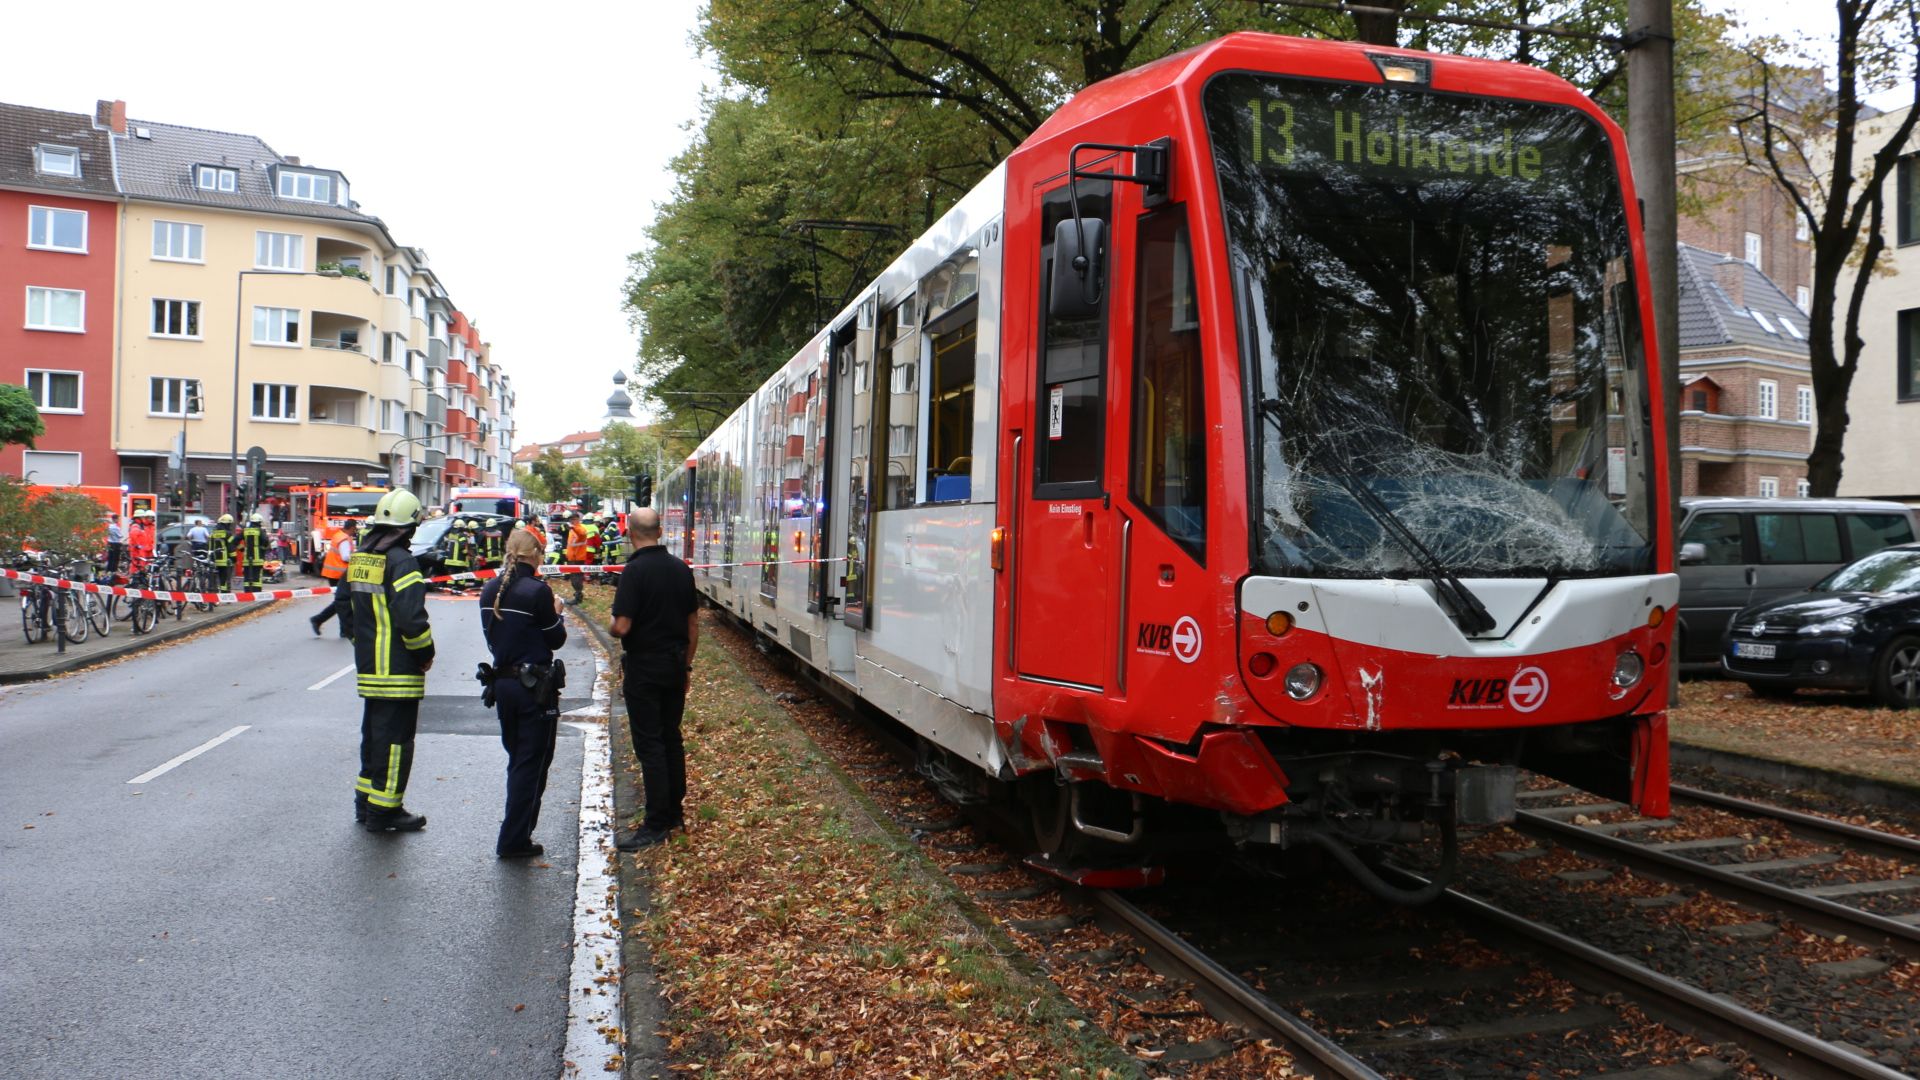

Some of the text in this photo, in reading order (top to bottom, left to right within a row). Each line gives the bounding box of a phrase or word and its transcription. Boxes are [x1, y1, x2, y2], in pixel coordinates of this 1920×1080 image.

[1248, 99, 1542, 180] 13 Holweide
[1049, 504, 1082, 516] Kein Einstieg
[353, 566, 370, 580] KÖLN
[1137, 623, 1172, 650] KVB
[1448, 678, 1508, 704] KVB
